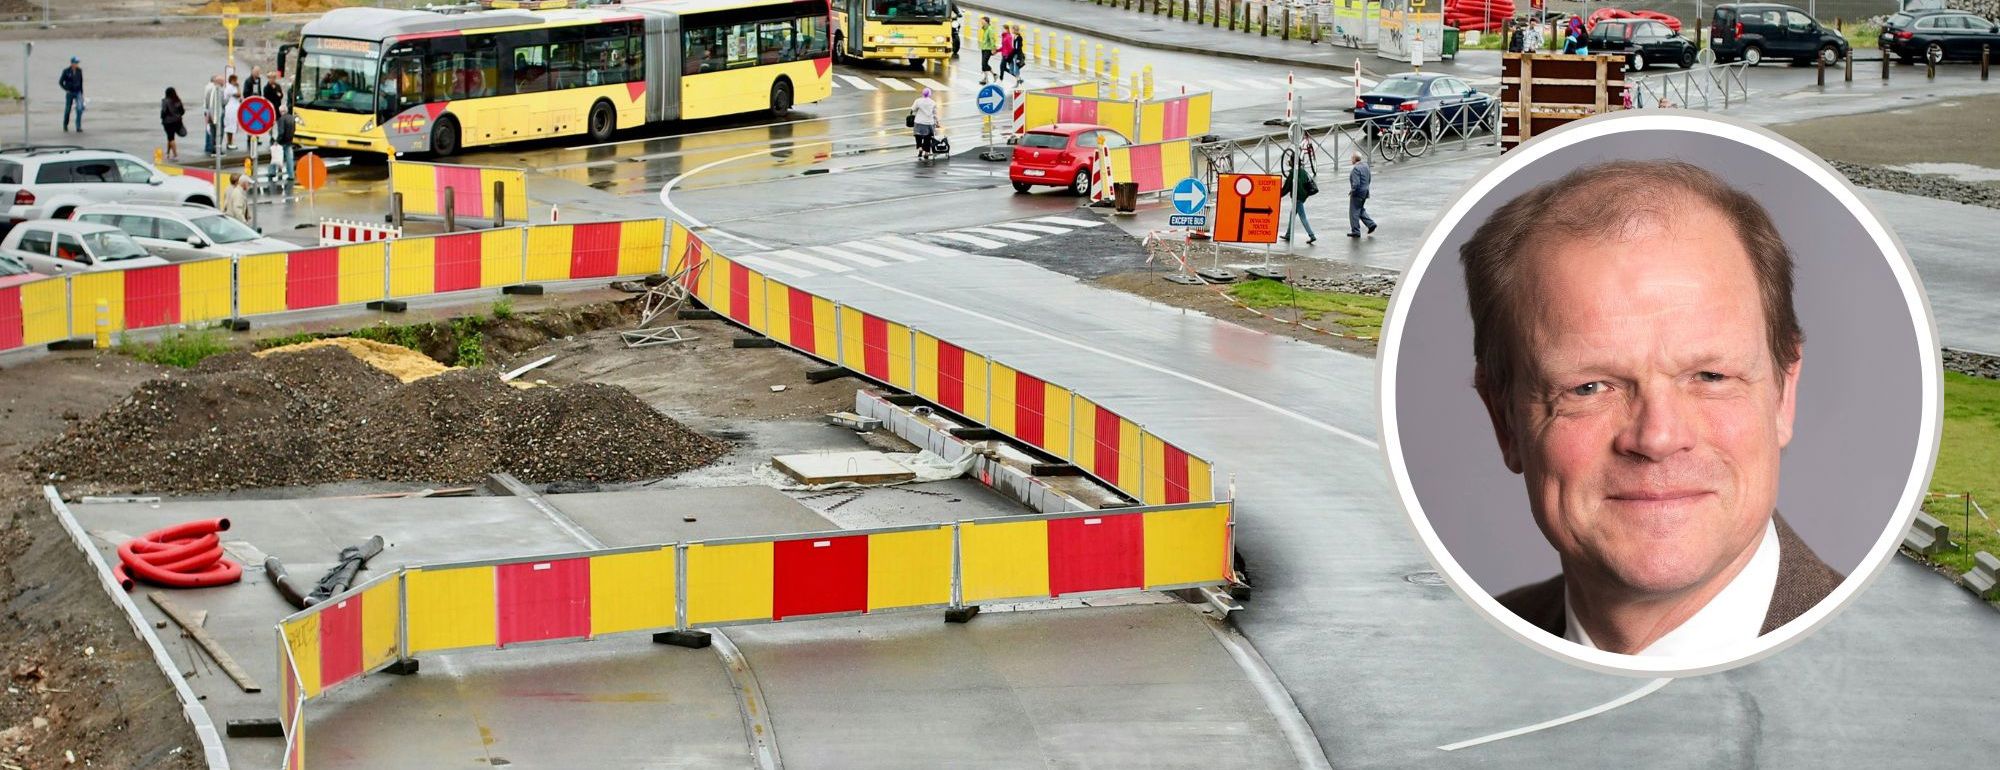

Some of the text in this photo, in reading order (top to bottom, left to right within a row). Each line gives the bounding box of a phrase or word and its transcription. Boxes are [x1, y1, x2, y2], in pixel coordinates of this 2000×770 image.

[397, 113, 425, 134] TEC
[1171, 216, 1204, 225] EXCEPTE BUS
